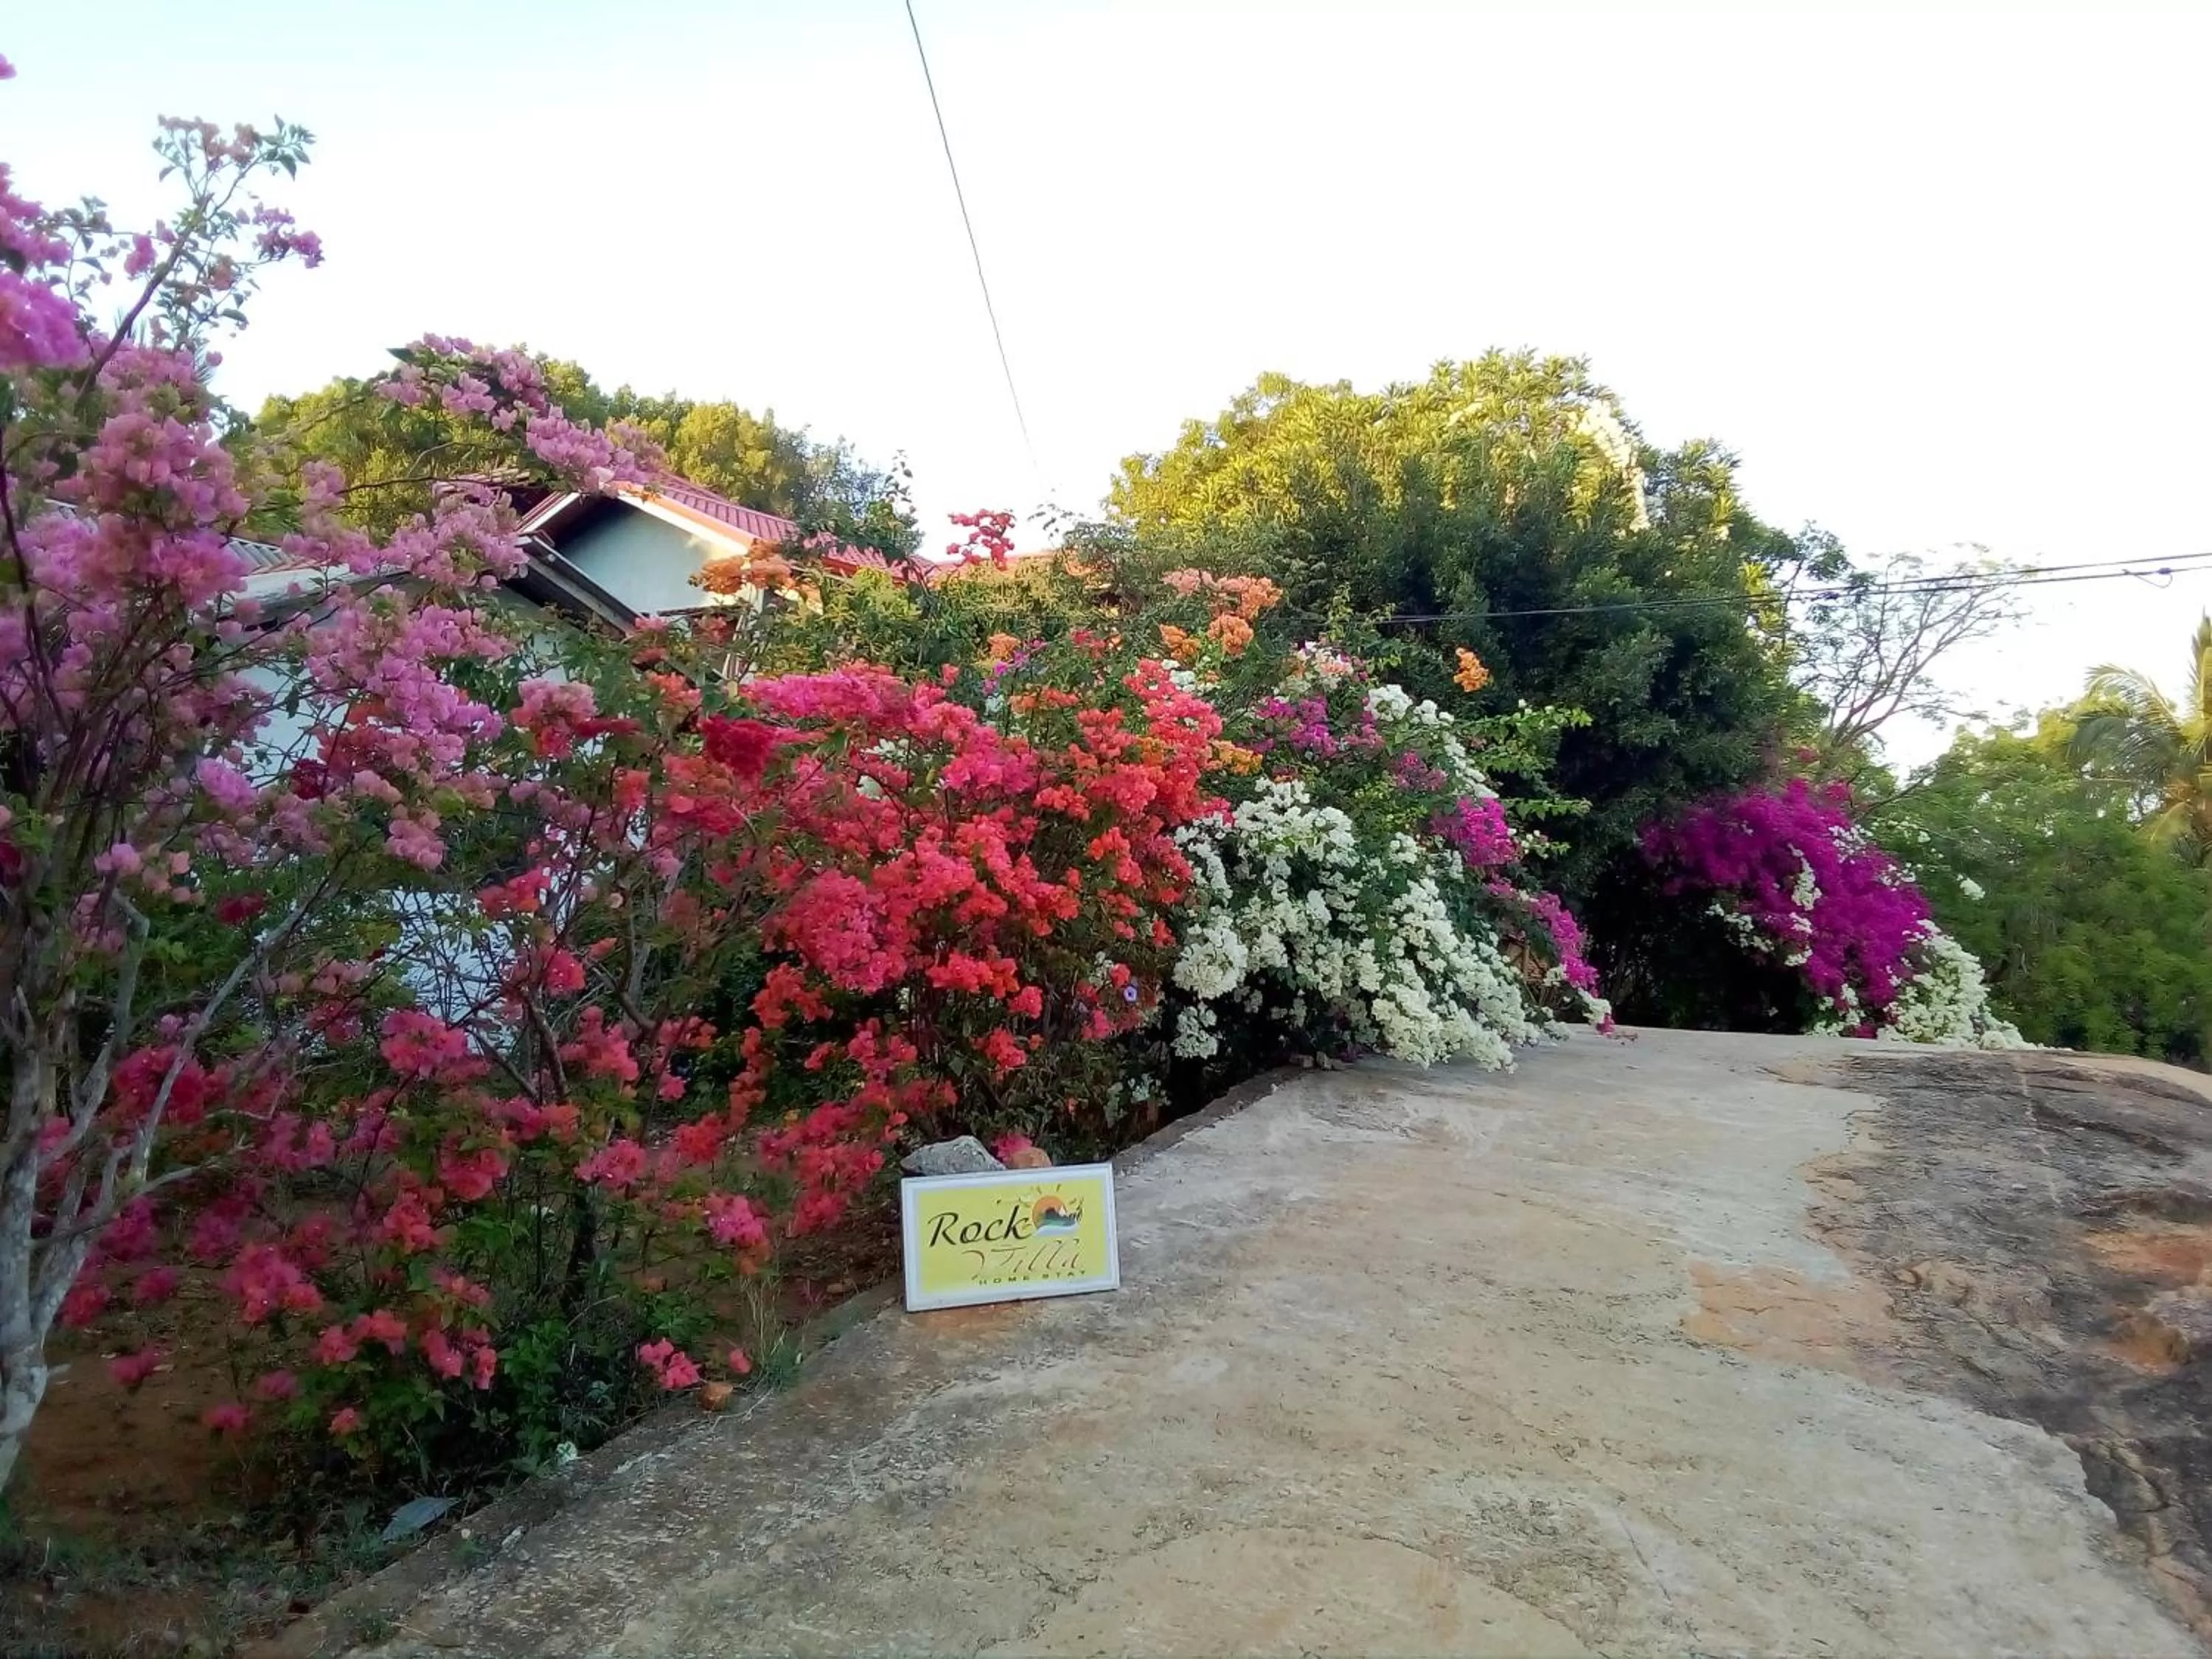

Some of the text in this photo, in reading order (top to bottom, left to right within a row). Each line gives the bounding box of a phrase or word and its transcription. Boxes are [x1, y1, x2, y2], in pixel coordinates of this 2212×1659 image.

[927, 1204, 1032, 1248] Rock
[978, 1269, 1086, 1286] HOME STAY
